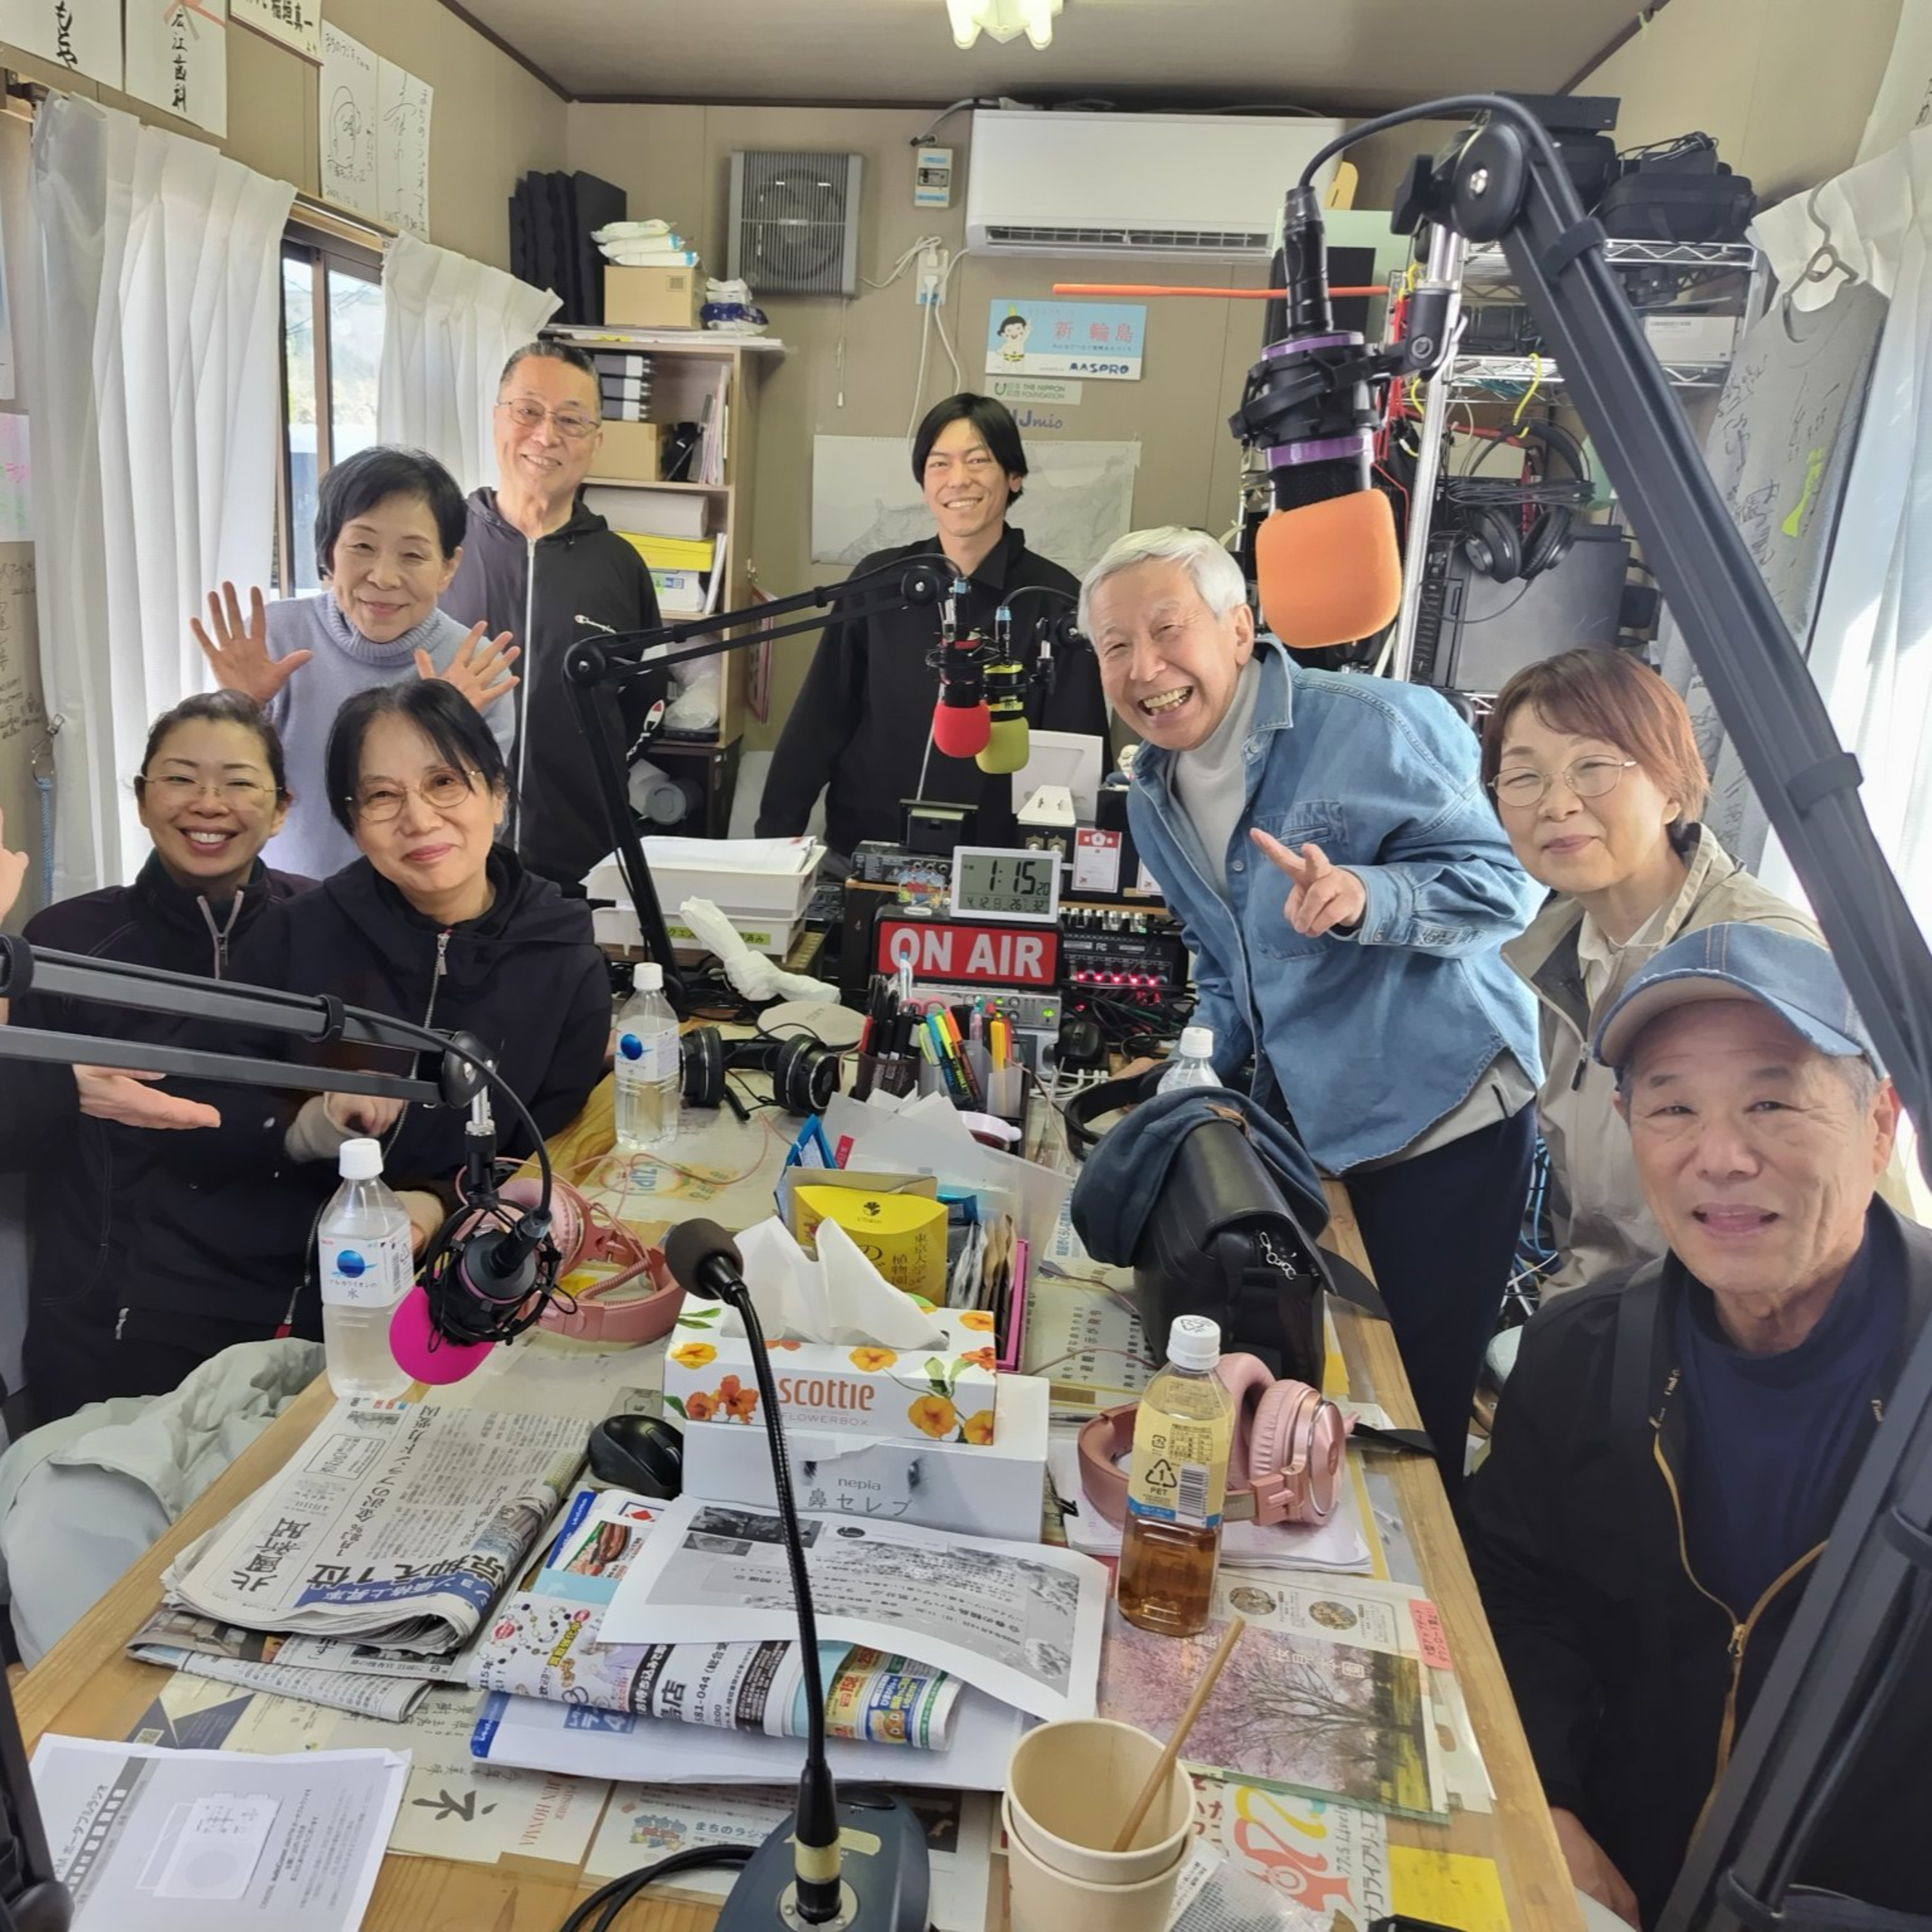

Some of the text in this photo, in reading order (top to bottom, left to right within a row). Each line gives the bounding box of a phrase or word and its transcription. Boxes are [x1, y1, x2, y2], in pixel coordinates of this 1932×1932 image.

[989, 860, 1050, 896] 1:15 20
[890, 927, 1044, 979] ON AIR
[348, 1289, 359, 1300] 水
[780, 1412, 869, 1426] FLOWERBOX
[838, 1477, 881, 1491] nepia
[1150, 1486, 1168, 1496] PET
[231, 1517, 312, 1593] 北國新聞
